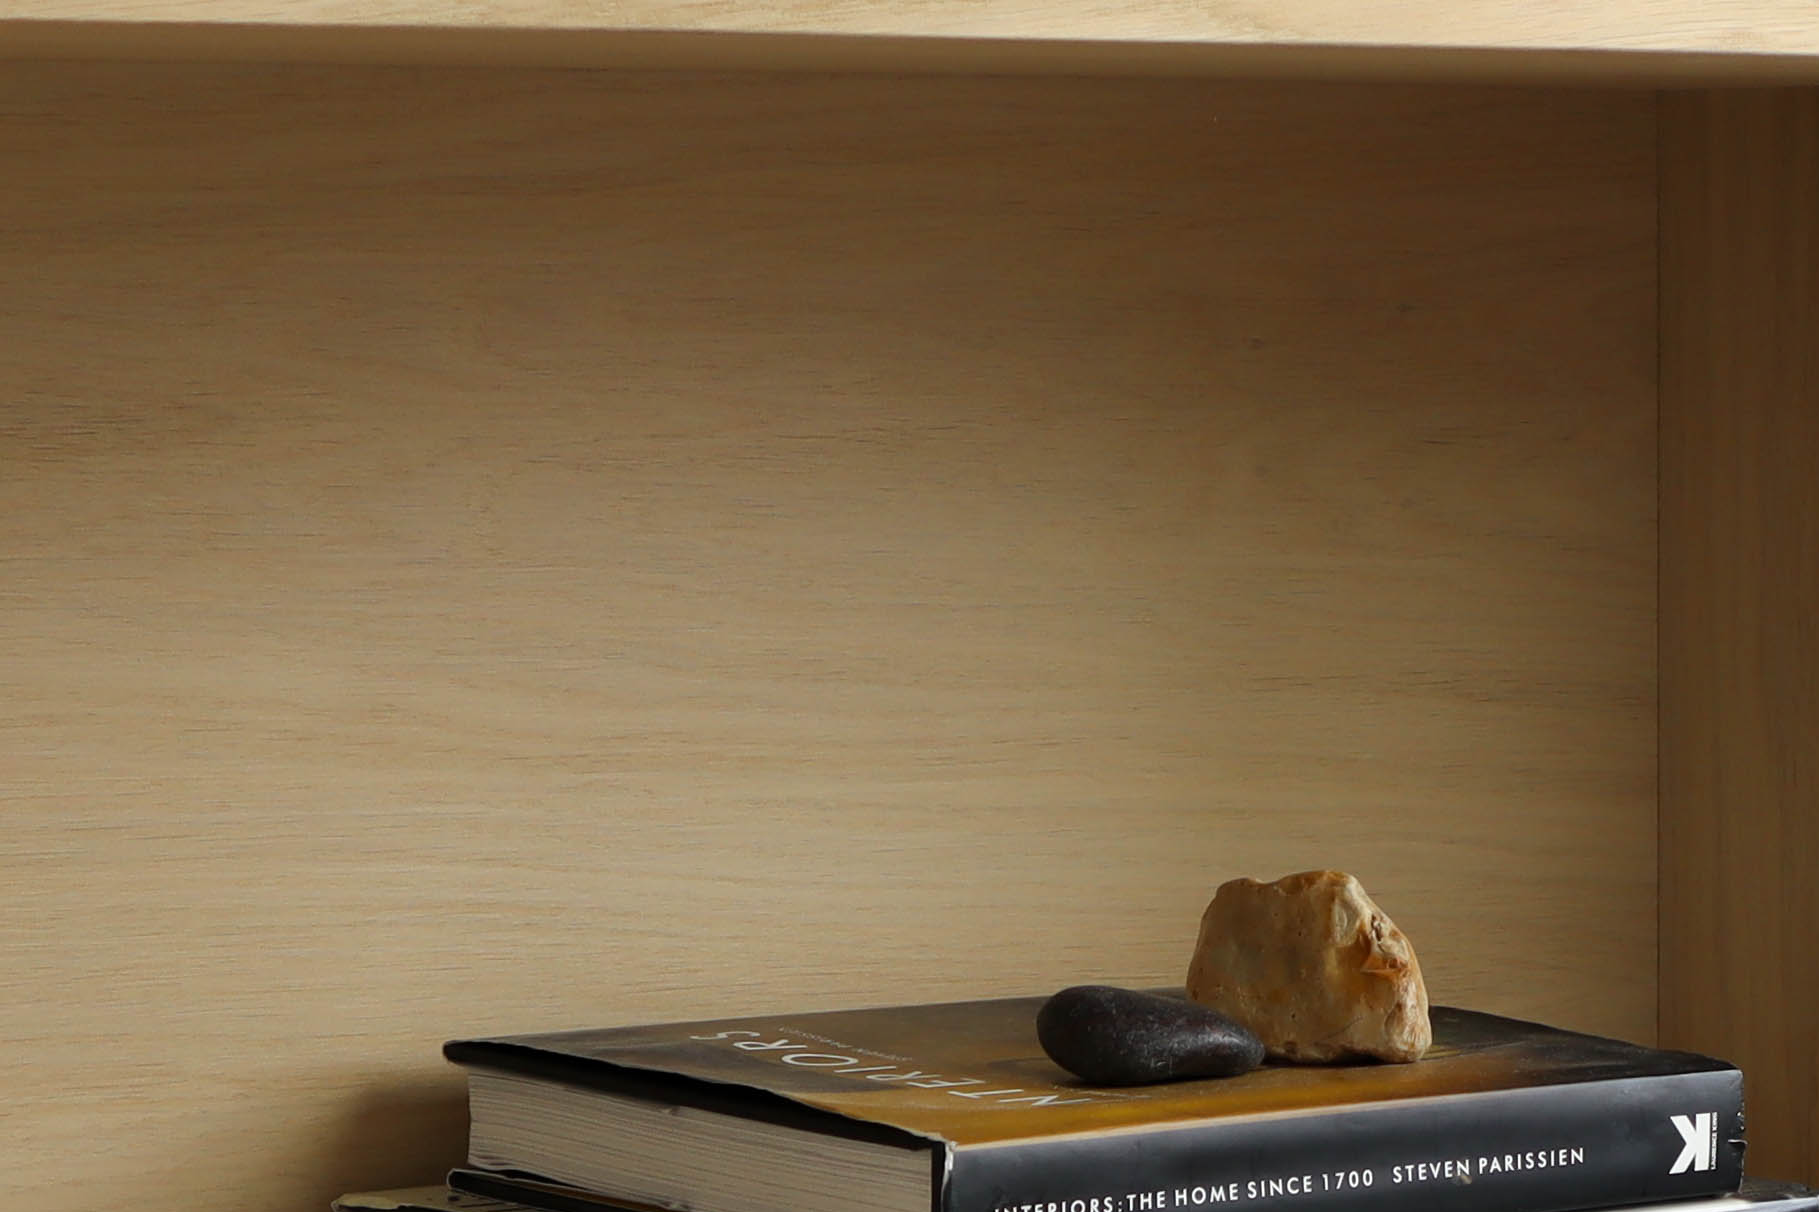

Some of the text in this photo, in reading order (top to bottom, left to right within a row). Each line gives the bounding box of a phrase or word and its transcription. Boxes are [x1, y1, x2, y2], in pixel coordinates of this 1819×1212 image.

[690, 1029, 1094, 1107] NTERIORS
[1174, 1183, 1239, 1207] HOME
[1247, 1175, 1313, 1199] SINCE
[1322, 1169, 1373, 1191] 1700
[1392, 1160, 1470, 1184] STEVEN
[1478, 1147, 1584, 1175] PARISSIEN
